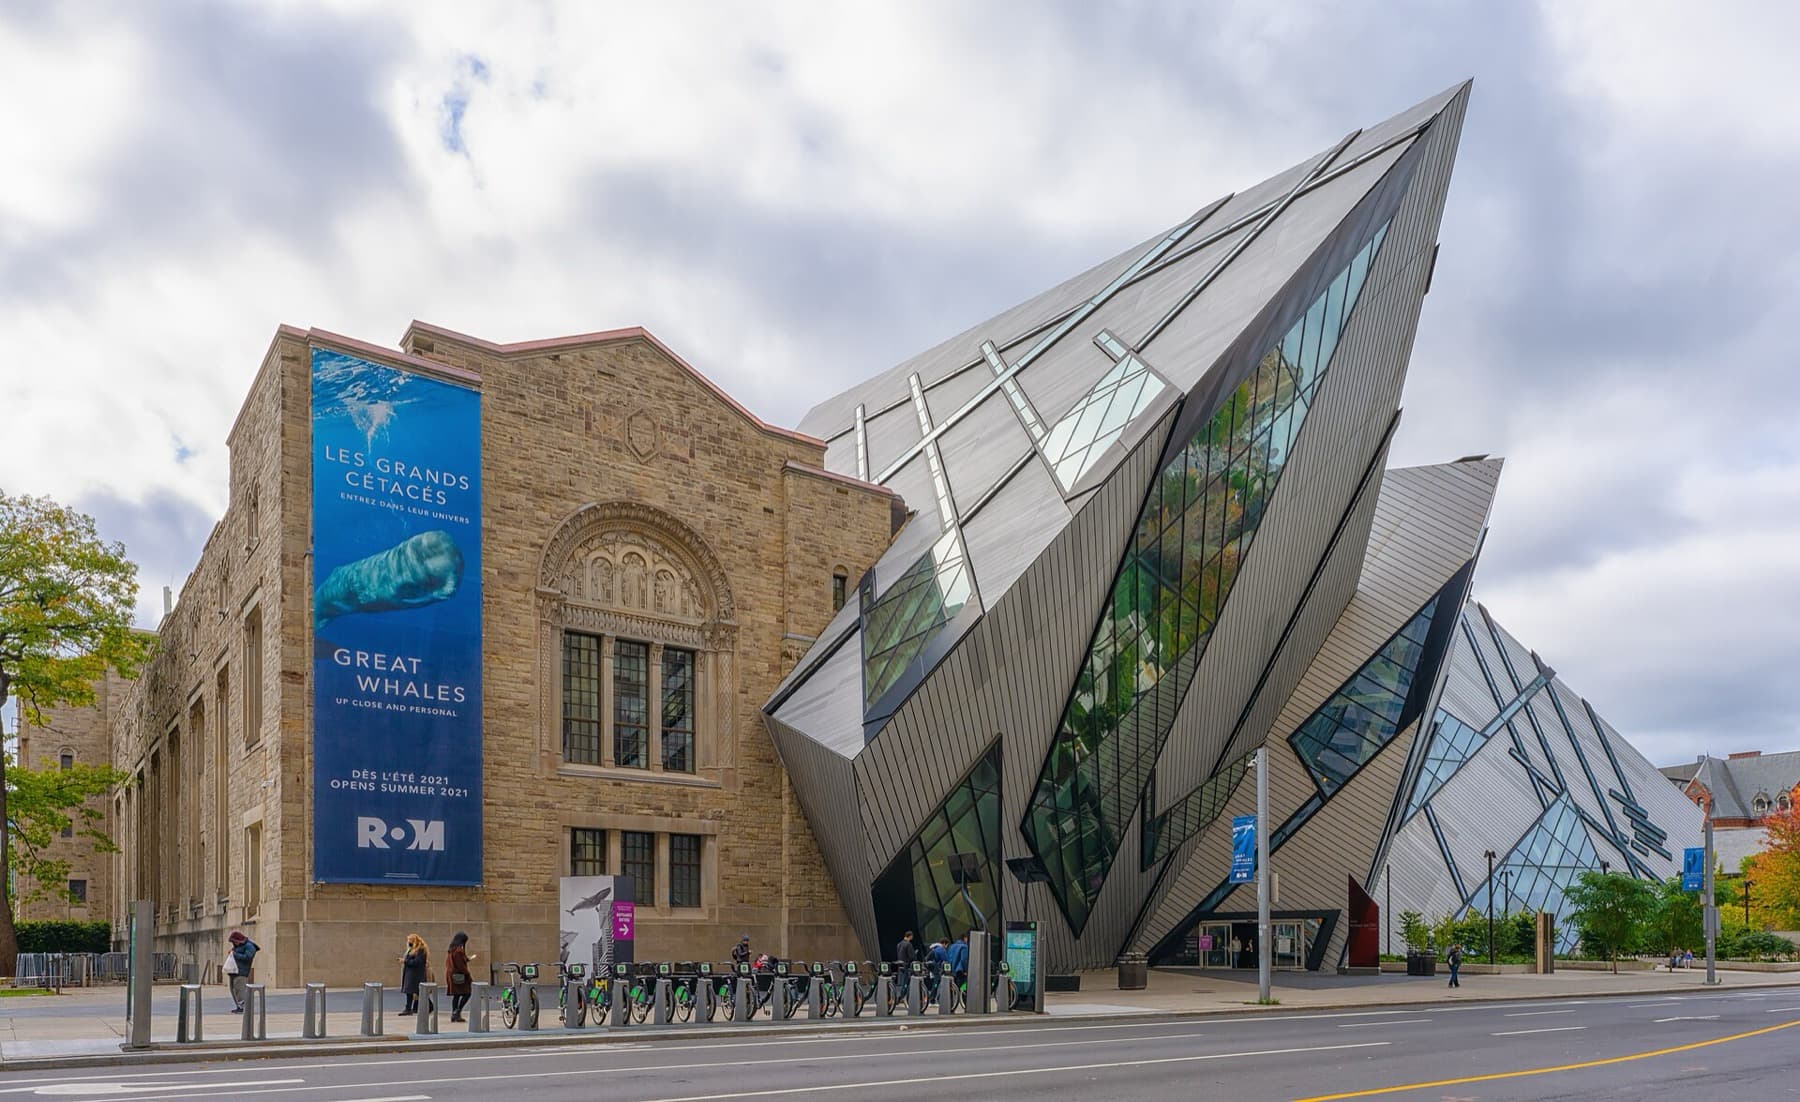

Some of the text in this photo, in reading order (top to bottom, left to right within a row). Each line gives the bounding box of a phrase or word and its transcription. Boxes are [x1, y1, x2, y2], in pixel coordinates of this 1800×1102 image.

[326, 445, 469, 490] LES GRANDS
[346, 471, 447, 505] CÉTACÉS
[340, 492, 470, 525] ENTREZ DANS LEUR UNIVERS
[334, 649, 422, 674] GREAT
[356, 675, 465, 703] WHALES
[352, 699, 383, 710] CLOSE
[386, 703, 407, 712] AND
[410, 706, 457, 717] PERSONAL
[330, 779, 468, 798] OPENS SUMMER 2021
[352, 769, 449, 785] DÈS L'ÉTÉ 2021
